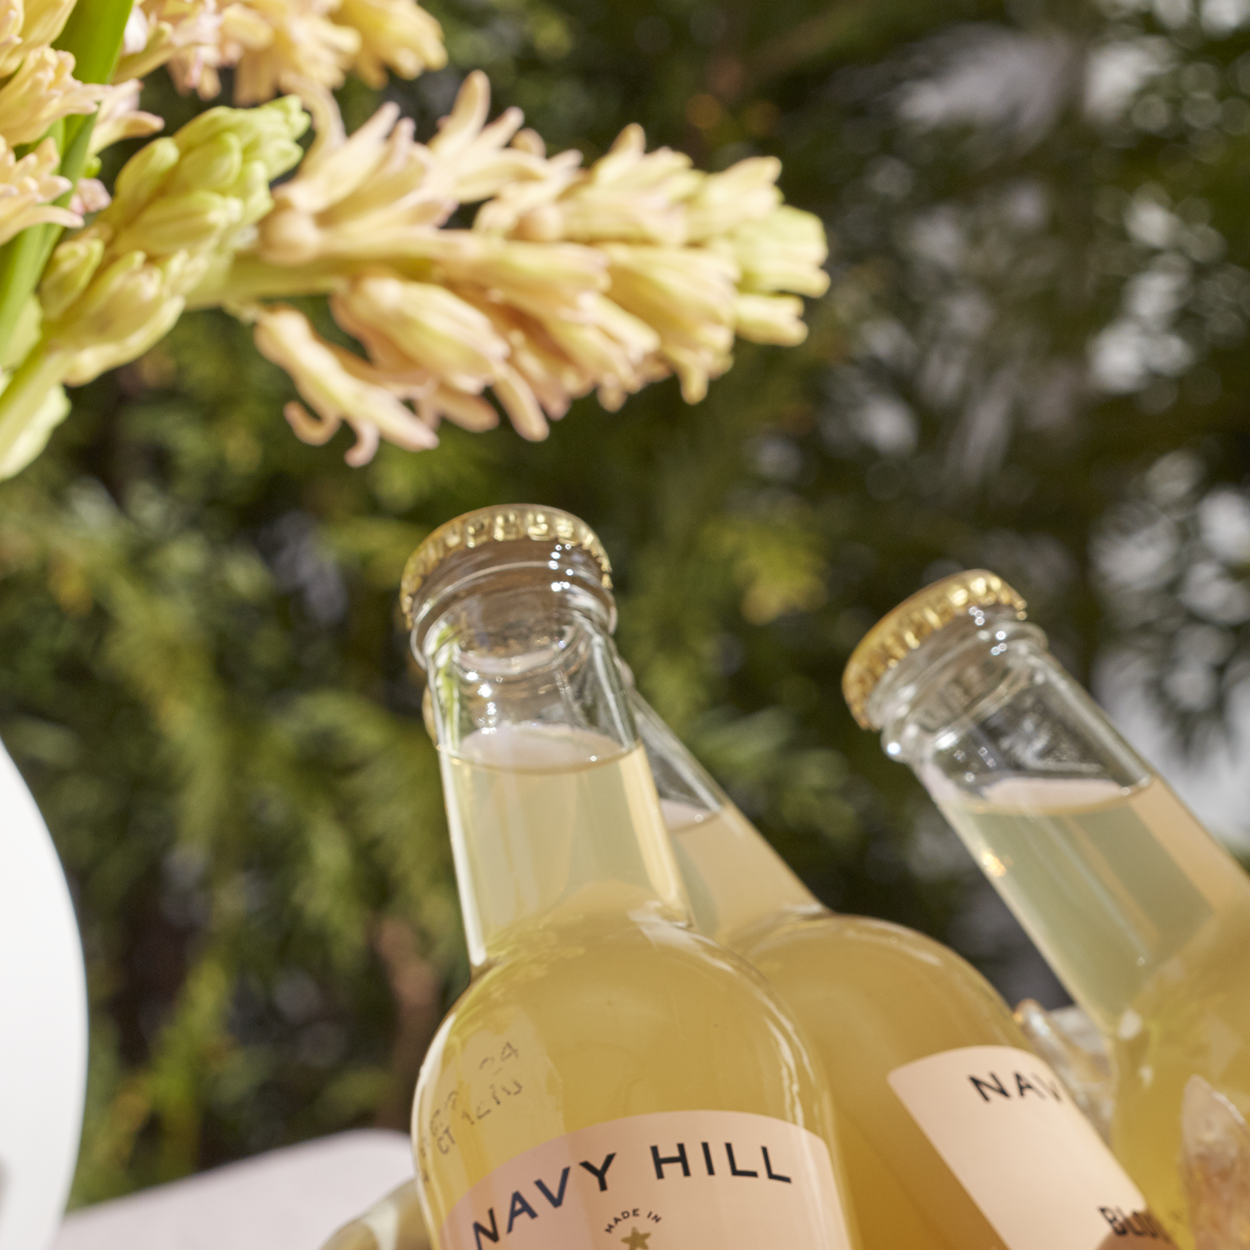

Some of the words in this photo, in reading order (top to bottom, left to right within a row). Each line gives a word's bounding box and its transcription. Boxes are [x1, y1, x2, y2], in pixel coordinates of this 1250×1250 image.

[967, 1071, 1062, 1103] NAV
[649, 1141, 792, 1184] HILL
[604, 1208, 640, 1234] MADE
[646, 1210, 662, 1224] IN
